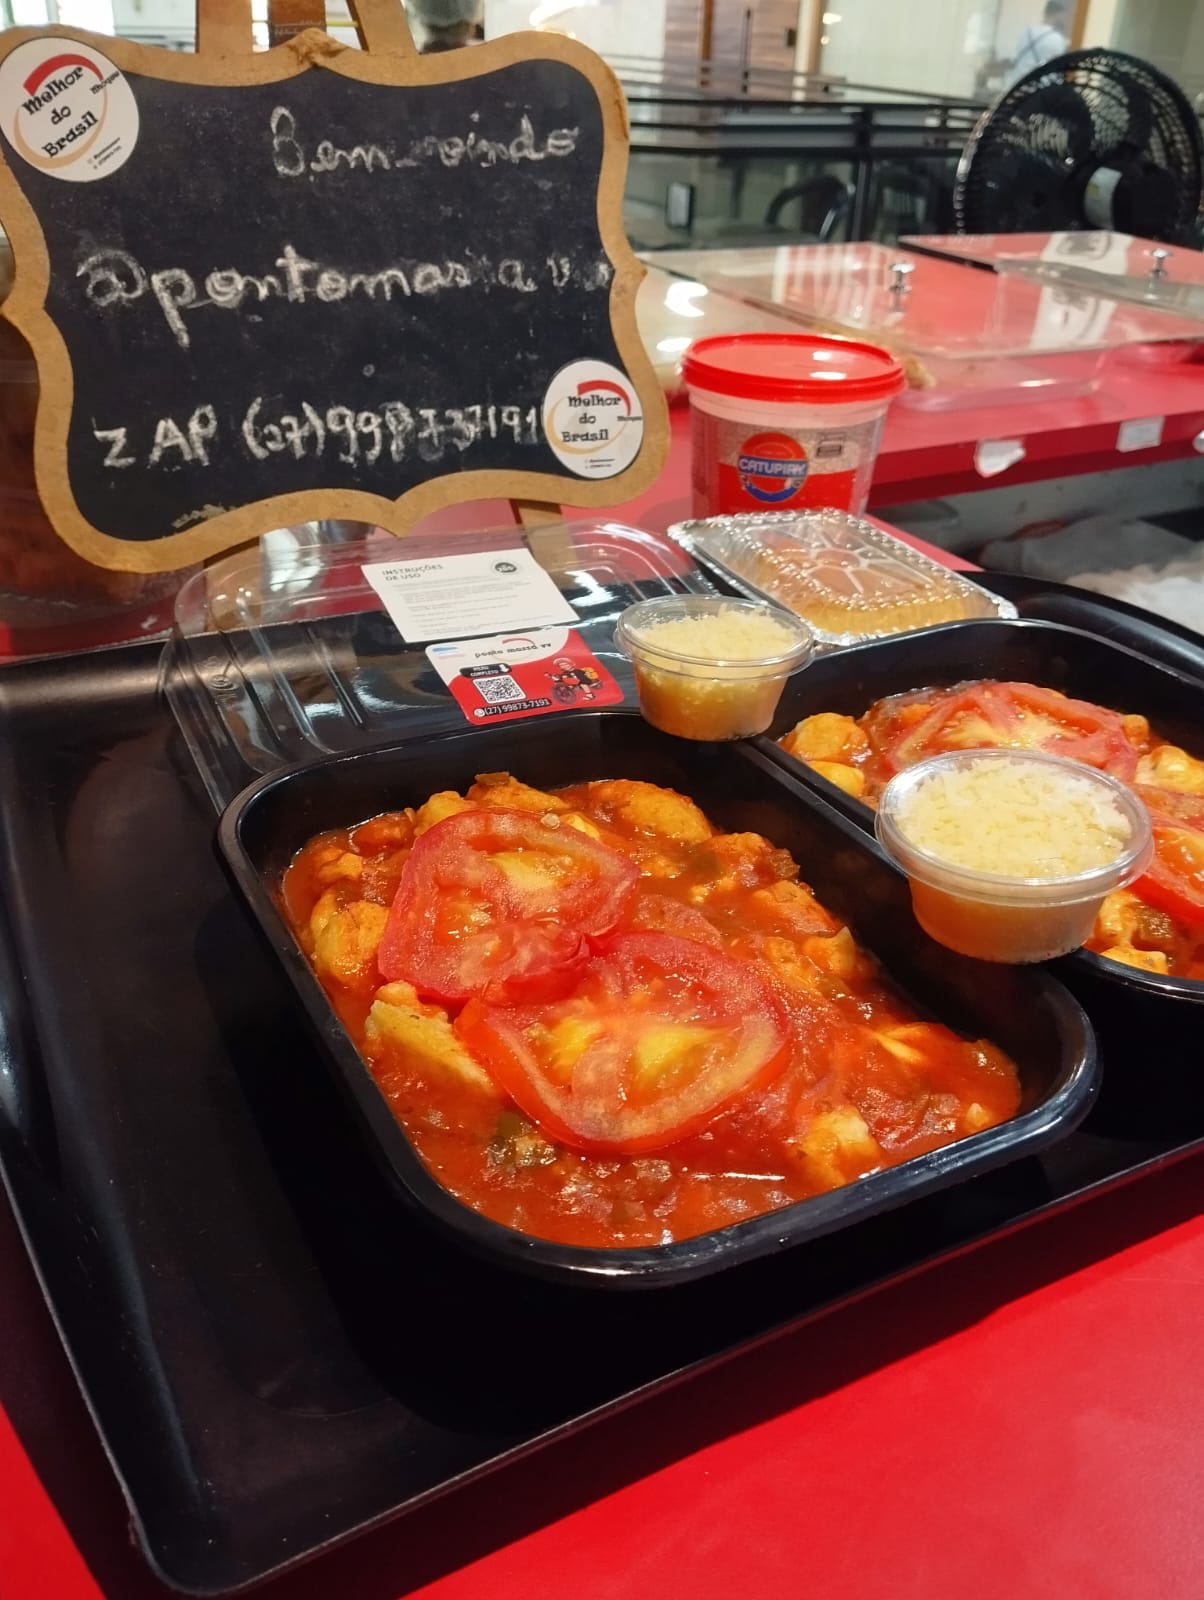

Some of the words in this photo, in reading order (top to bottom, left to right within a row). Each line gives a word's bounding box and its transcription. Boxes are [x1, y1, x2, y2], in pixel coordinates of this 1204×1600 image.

[22, 66, 83, 116] Melhor
[50, 105, 72, 125] do
[41, 110, 99, 158] Brasil
[567, 394, 622, 408] Melhor
[578, 412, 597, 425] do
[561, 428, 610, 443] Brasil
[738, 457, 807, 478] CATUPIRY
[484, 706, 502, 716] (27)
[501, 698, 550, 713] 99873-7191
